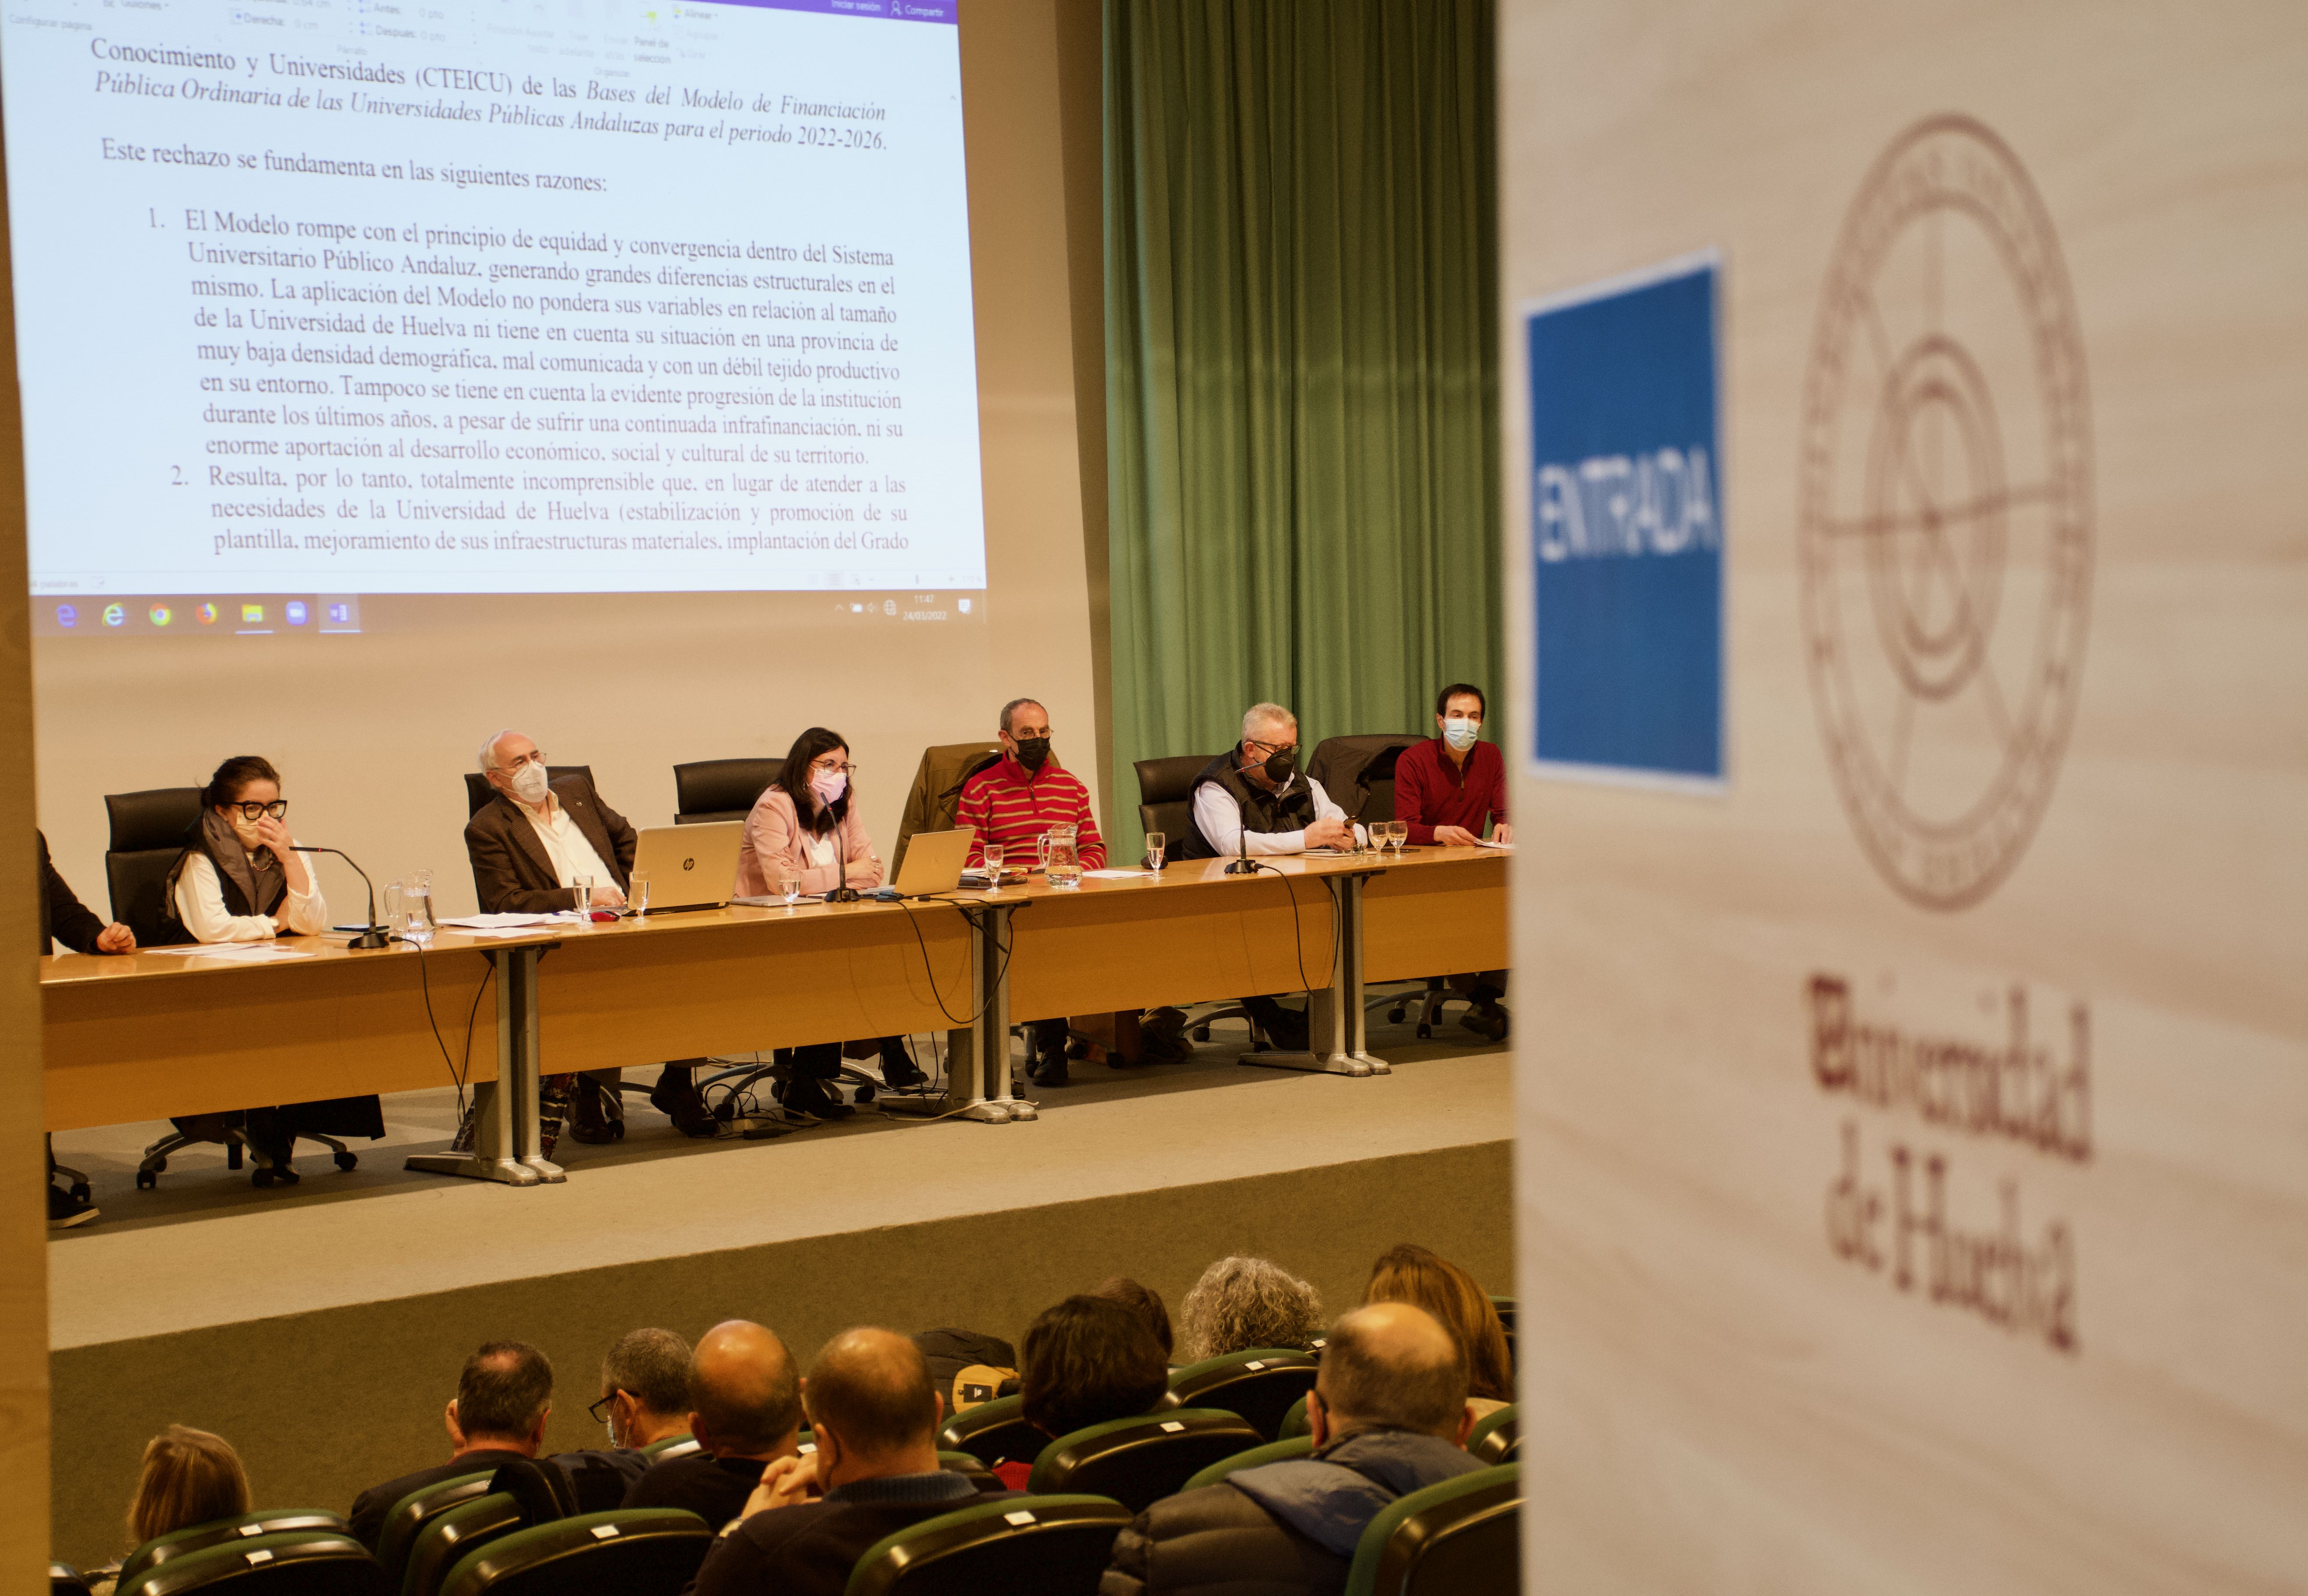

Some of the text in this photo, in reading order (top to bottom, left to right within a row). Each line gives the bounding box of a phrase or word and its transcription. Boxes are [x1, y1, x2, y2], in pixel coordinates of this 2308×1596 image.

[8, 13, 92, 32] Configurar página
[684, 9, 711, 19] Alinear
[905, 5, 943, 17] Compartir
[634, 36, 656, 47] Panel
[658, 38, 669, 48] de
[91, 38, 885, 120] Conocimiento y Universidades (CTEICU) de las Bases del Modelo de Financiación
[96, 71, 886, 150] Pública Ordinaria de las Universidades Públicas Andaluzas para el periodo 2022-2026.
[102, 138, 606, 191] Este rechazo se fundamenta en las siguientes razones:
[150, 208, 893, 265] 1. El Modelo rompe con el principio de equidad y convergencia dentro del Sistema
[188, 242, 894, 294] Universitario Público generando grandes diferencias estructurales en el
[192, 275, 896, 323] mismo. La aplicación del Modelo no pondera sus variables en relación al tamaño
[195, 306, 897, 354] de la Universidad de Huelva ni tiene en cuenta su situación en una provincia de
[197, 341, 899, 383] muy baja densidad mal comunicada y con un débil tejido productivo
[200, 375, 901, 409] en su entorno. Tampoco se tiene en cuenta la evidente progresión de la institución
[206, 437, 868, 467] enorme aportación al desarrollo social y cultural de su territorio.
[212, 498, 907, 525] necesidades de la Universidad de Huelva (estabilización y promoción de su
[1538, 446, 1721, 562] ENTRADA
[684, 858, 694, 871] hp
